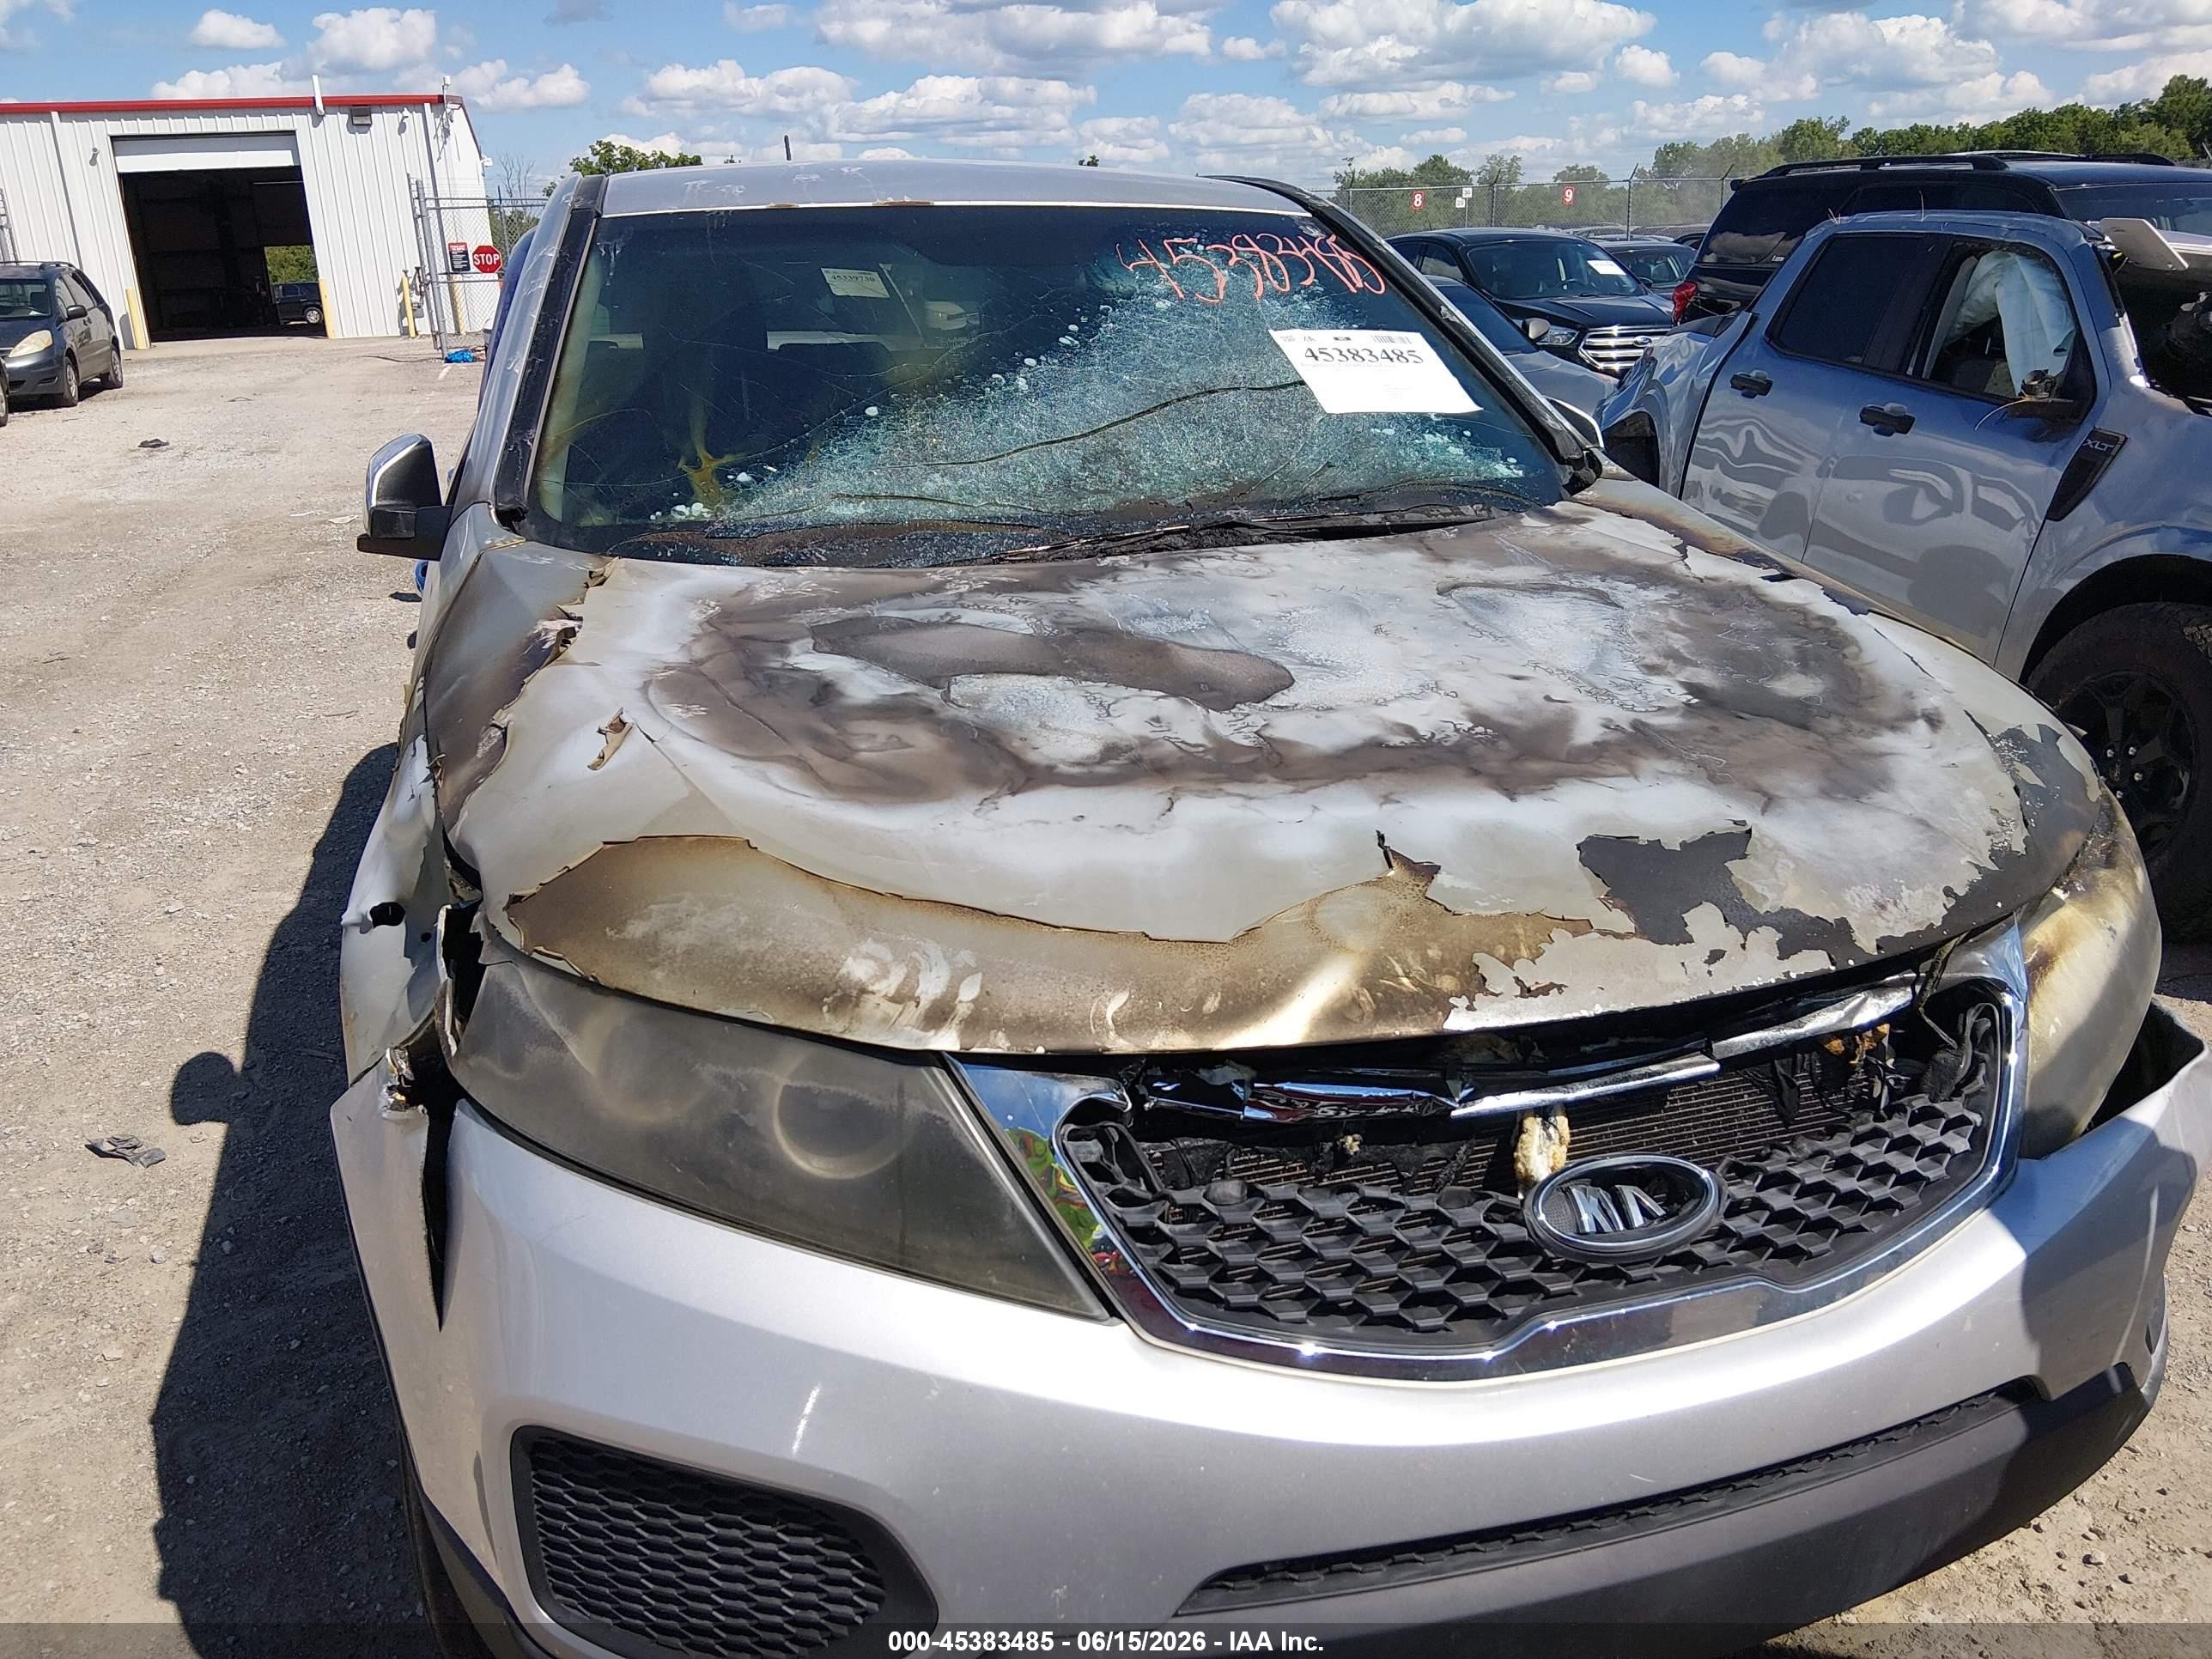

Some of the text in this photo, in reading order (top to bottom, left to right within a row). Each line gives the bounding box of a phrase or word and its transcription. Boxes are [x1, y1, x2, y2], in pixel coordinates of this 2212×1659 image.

[1413, 193, 1423, 207] 8
[1565, 188, 1573, 203] 9
[473, 253, 500, 265] STOP
[1304, 347, 1424, 364] 45383485
[2082, 439, 2115, 452] XLT
[1570, 1184, 1666, 1234] KIA
